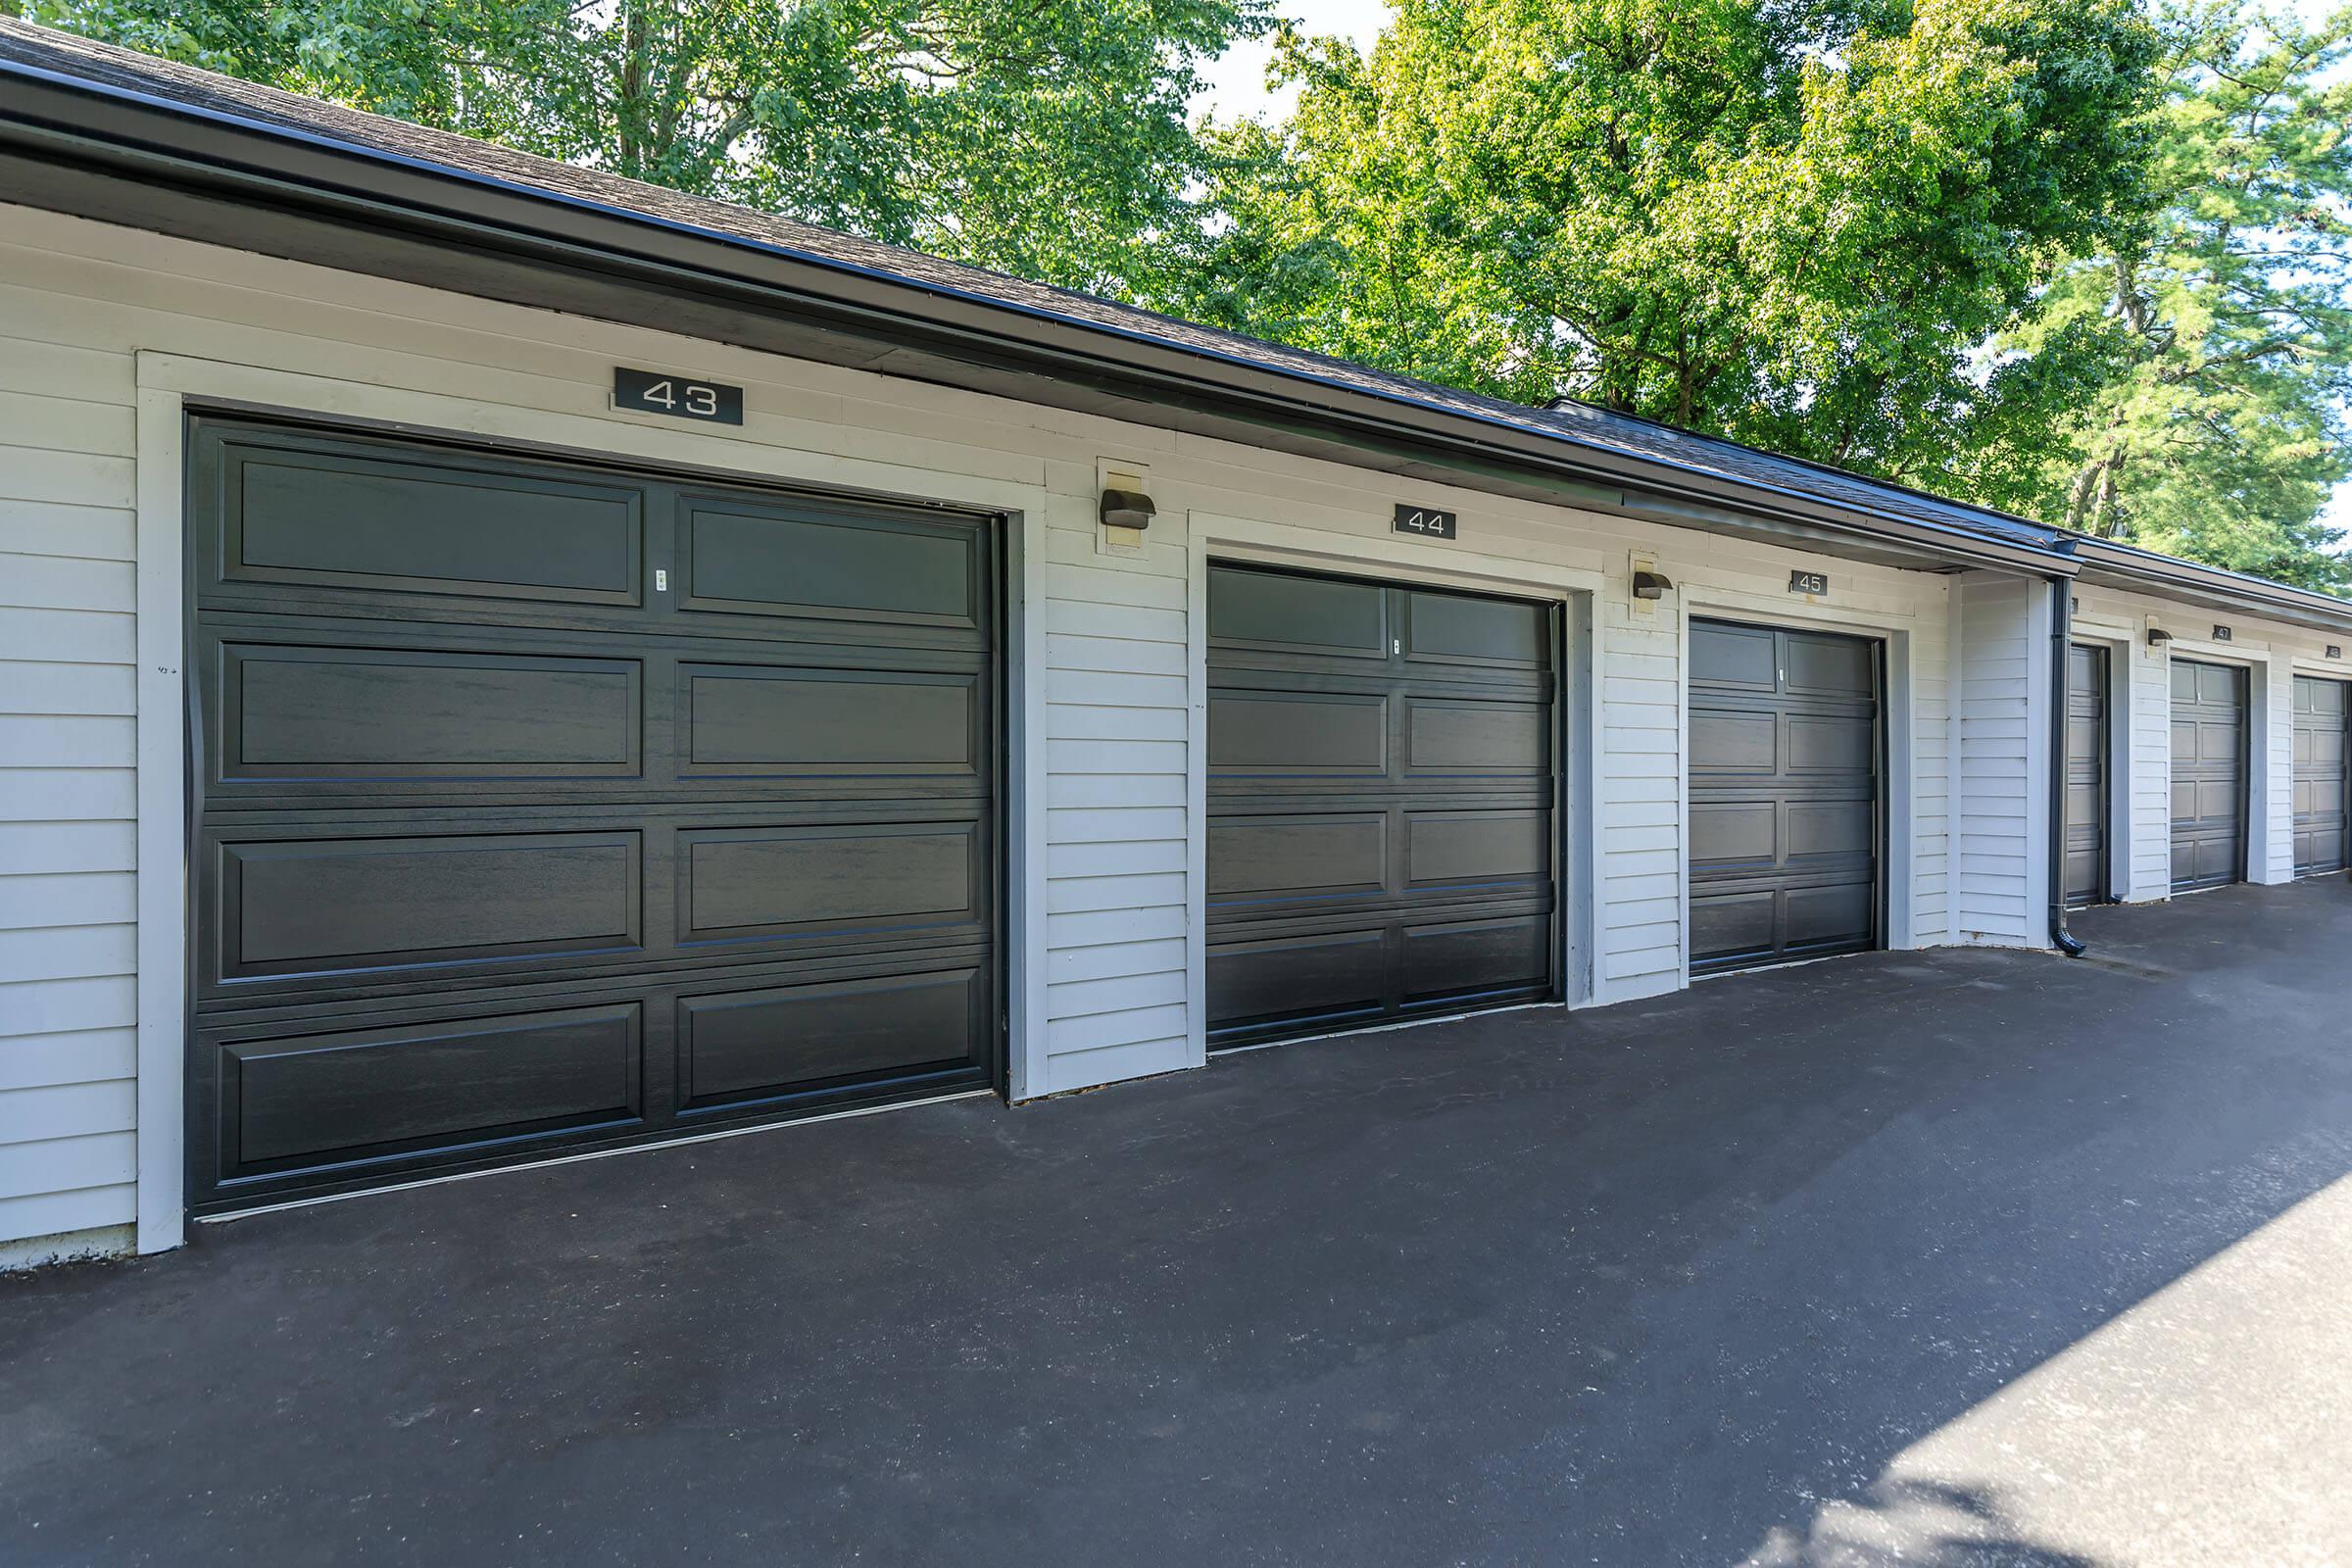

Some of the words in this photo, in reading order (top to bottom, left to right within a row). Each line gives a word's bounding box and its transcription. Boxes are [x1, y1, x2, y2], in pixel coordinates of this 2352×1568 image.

[643, 380, 716, 416] 43
[1409, 512, 1444, 533] 44
[1800, 575, 1821, 592] 45
[2218, 628, 2229, 638] 47
